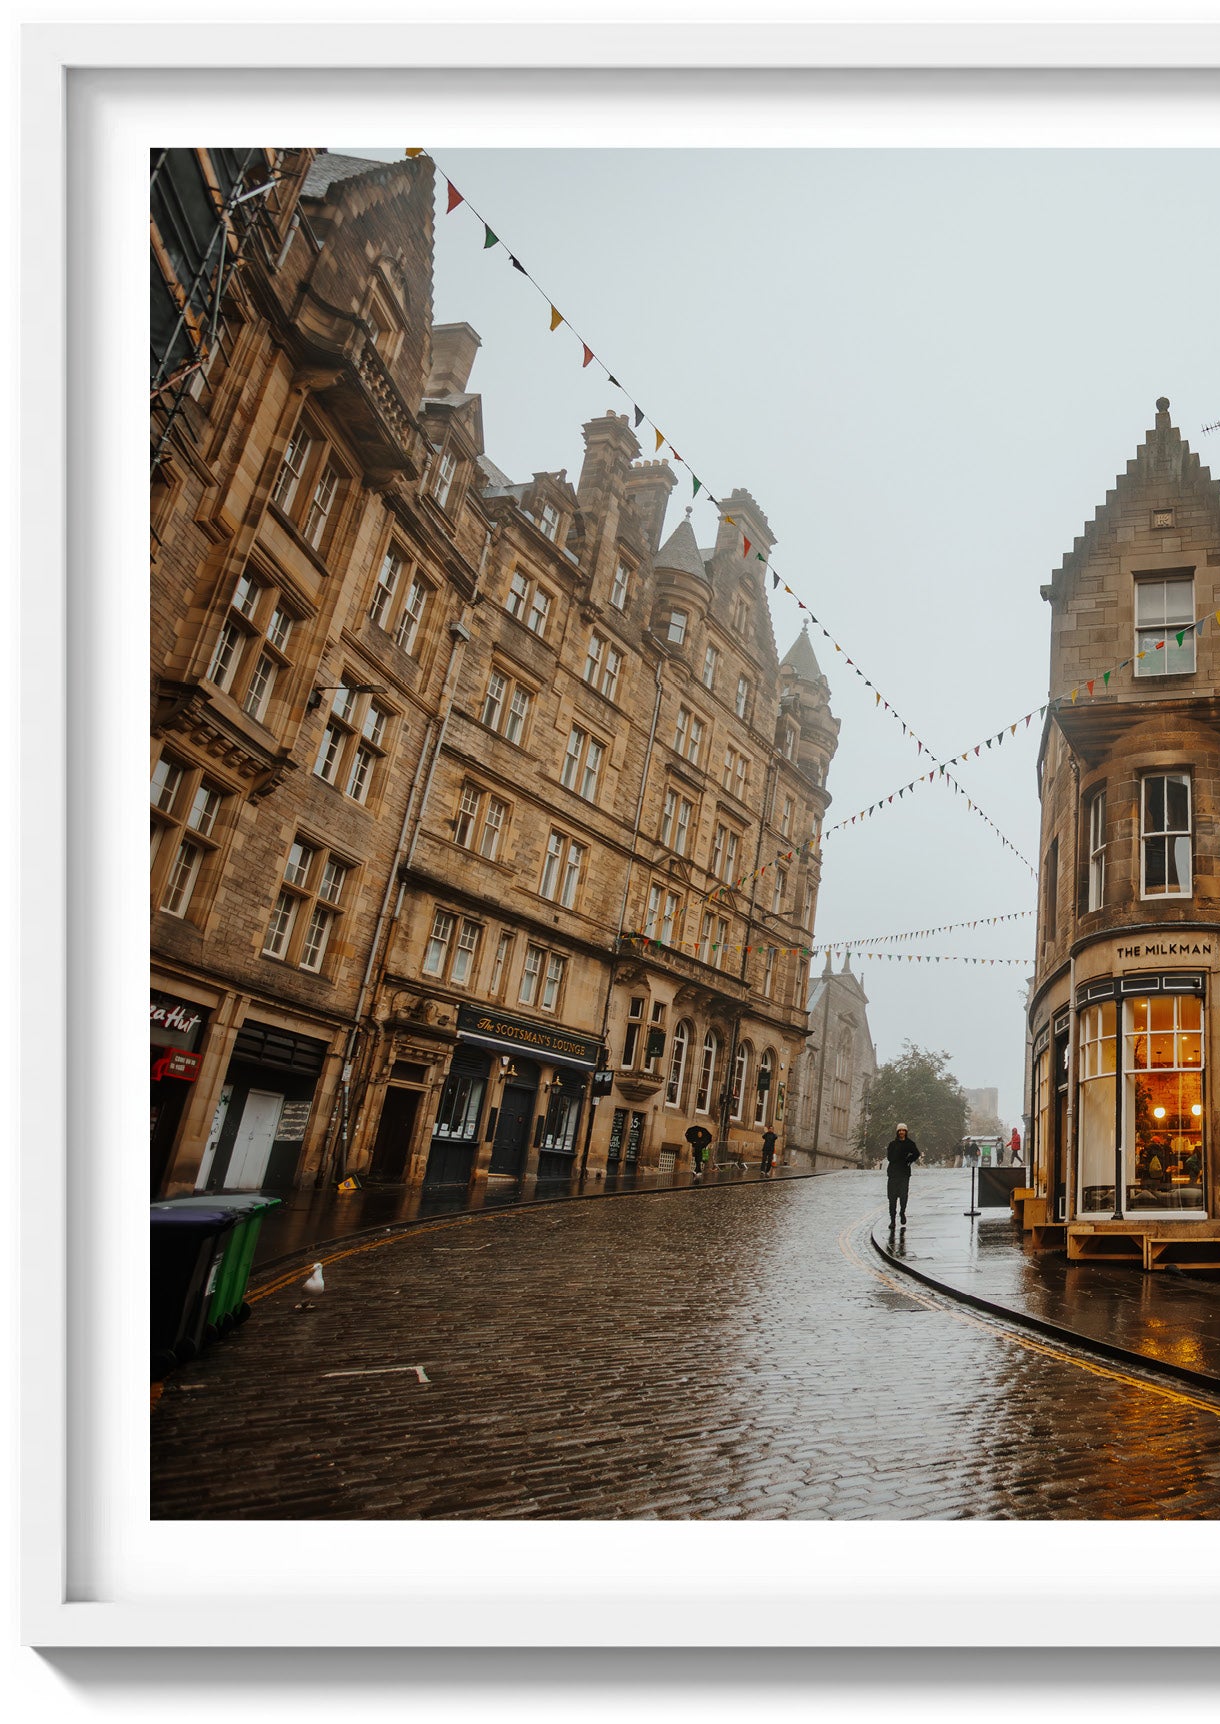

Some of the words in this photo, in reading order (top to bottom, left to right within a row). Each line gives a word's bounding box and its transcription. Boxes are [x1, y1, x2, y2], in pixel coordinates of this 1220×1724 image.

[1117, 946, 1140, 958] THE
[1145, 944, 1211, 955] MILKMAN
[164, 1005, 202, 1034] Hut
[477, 1018, 495, 1032] The
[495, 1023, 552, 1047] SCOTSMAN'S
[552, 1038, 586, 1056] LOUNGE
